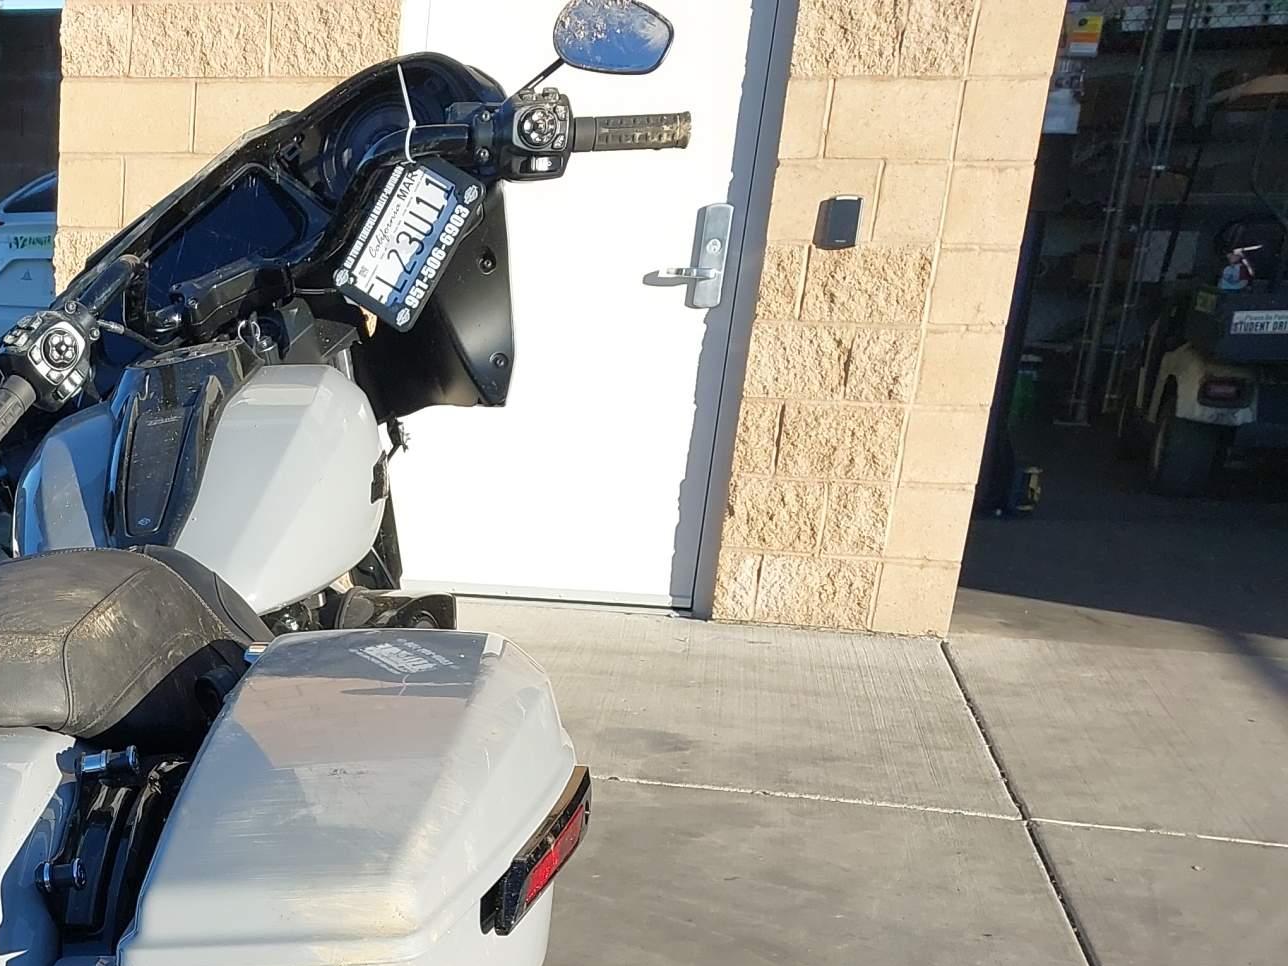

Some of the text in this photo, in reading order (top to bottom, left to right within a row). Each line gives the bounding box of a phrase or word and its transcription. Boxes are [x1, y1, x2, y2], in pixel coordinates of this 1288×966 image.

[368, 172, 418, 258] California MAR
[404, 204, 470, 309] 951-506-6903
